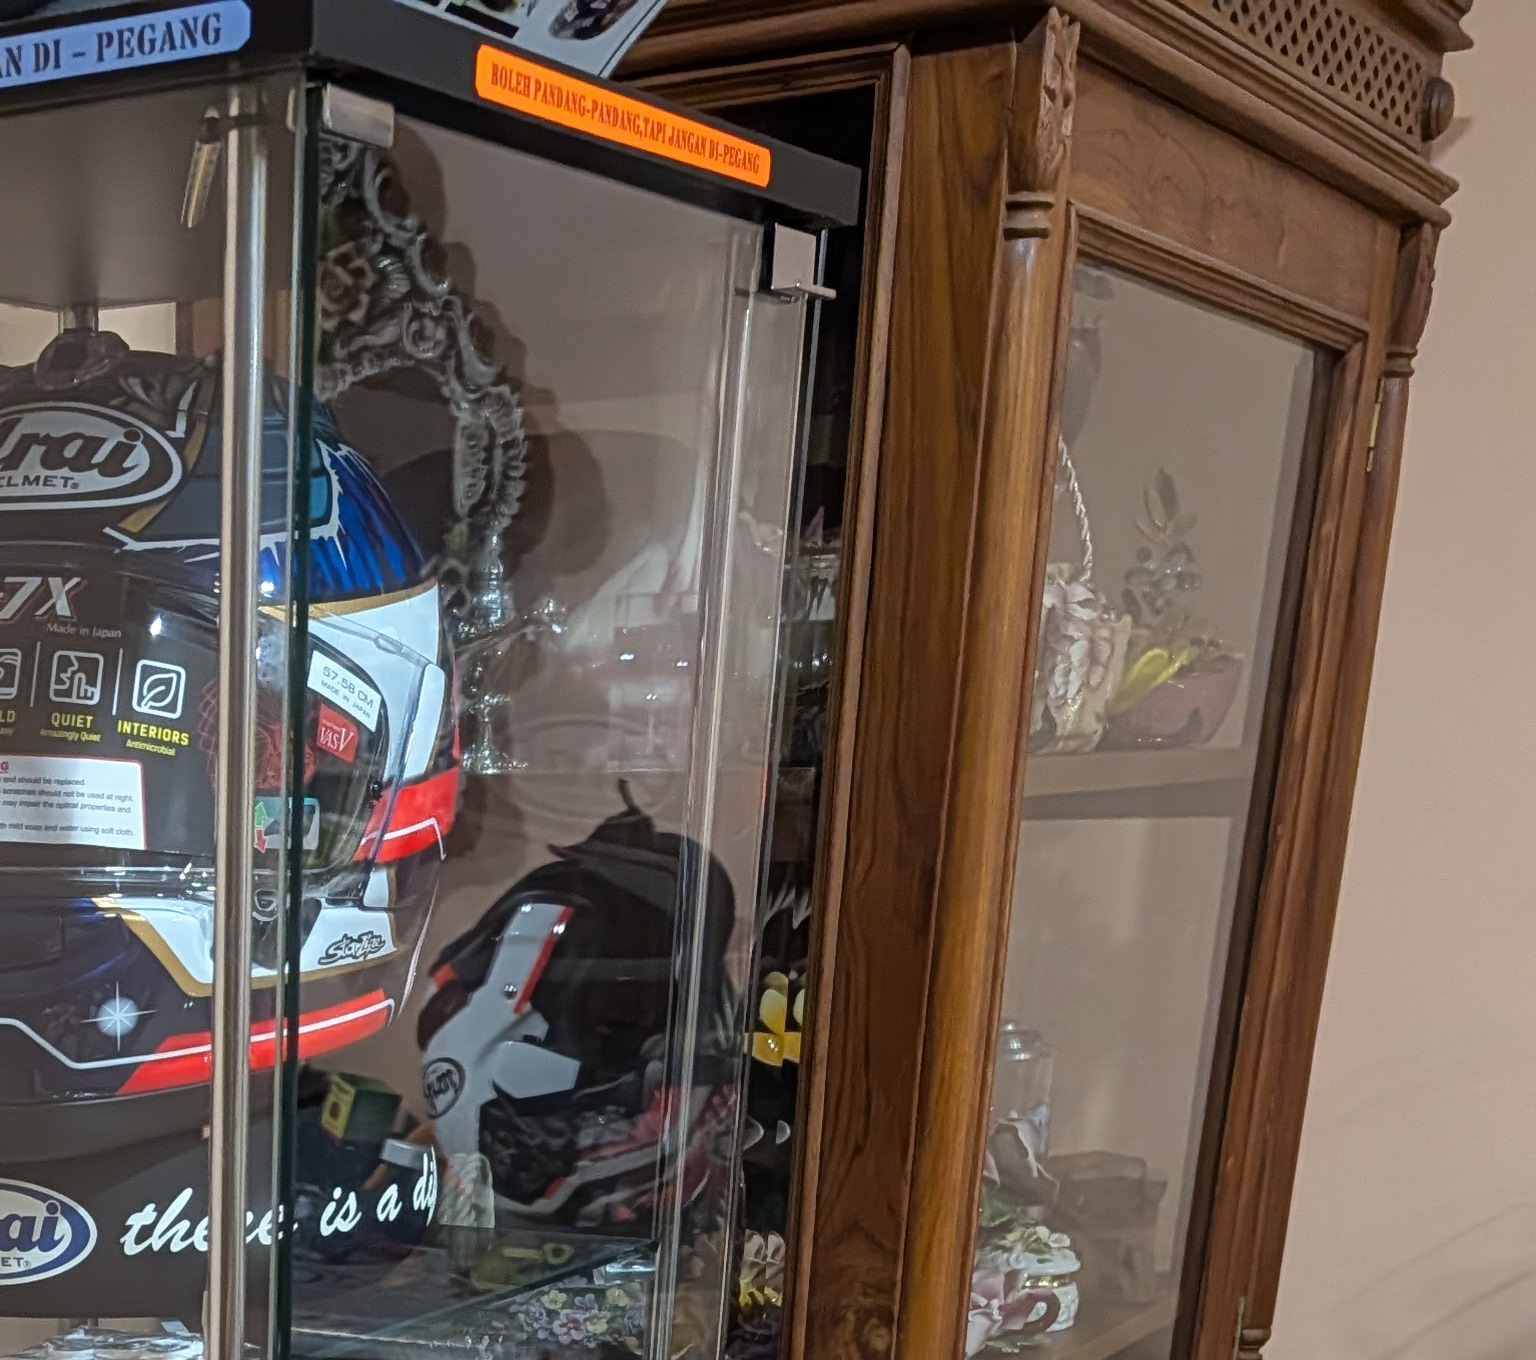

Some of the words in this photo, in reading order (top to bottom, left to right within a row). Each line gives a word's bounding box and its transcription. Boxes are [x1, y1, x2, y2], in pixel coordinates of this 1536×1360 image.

[34, 39, 62, 74] DI
[96, 12, 223, 64] PEGANG
[491, 63, 531, 99] BOLEH
[668, 126, 707, 156] JANGAN
[46, 623, 77, 635] Made
[79, 626, 90, 636] in
[93, 626, 122, 639] Japan
[357, 688, 375, 709] CM
[50, 712, 94, 729] QUIET
[117, 719, 191, 747] INTERIORS
[320, 1186, 363, 1237] is
[376, 1183, 402, 1222] a
